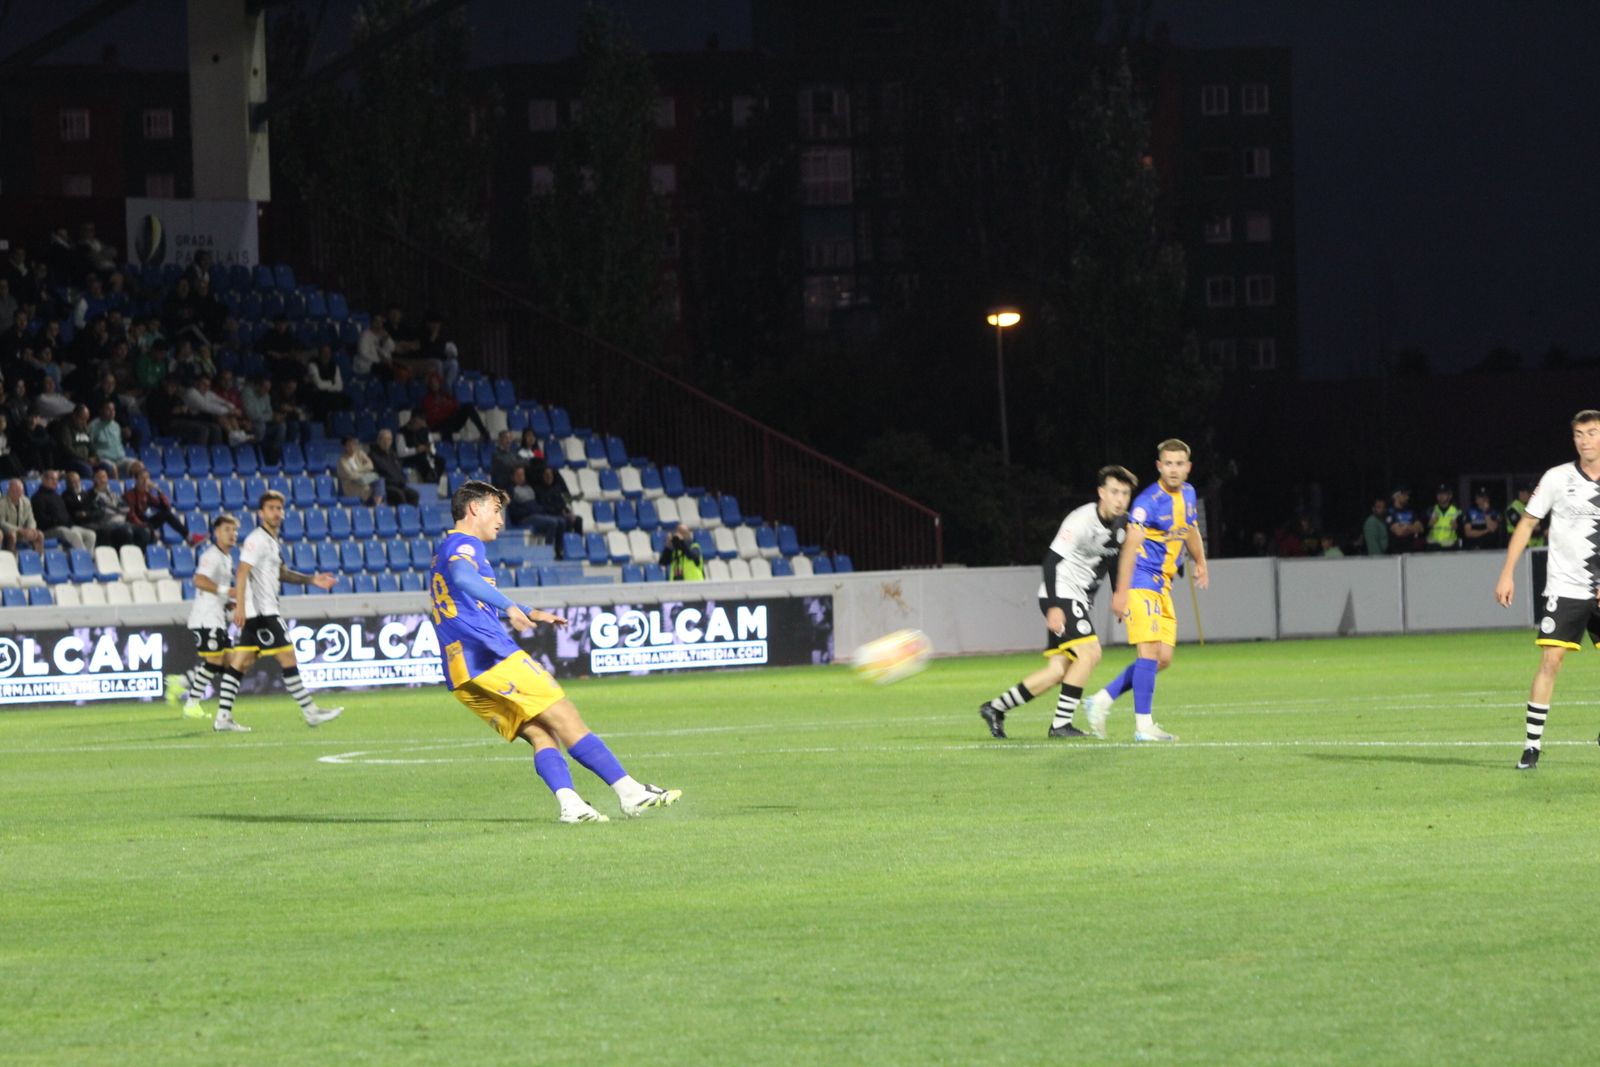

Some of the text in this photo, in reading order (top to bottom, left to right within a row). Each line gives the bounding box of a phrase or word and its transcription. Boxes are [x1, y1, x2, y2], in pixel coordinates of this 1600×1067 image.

[1072, 598, 1084, 618] 6
[1143, 599, 1161, 616] 14
[589, 605, 767, 649] GOLCAM
